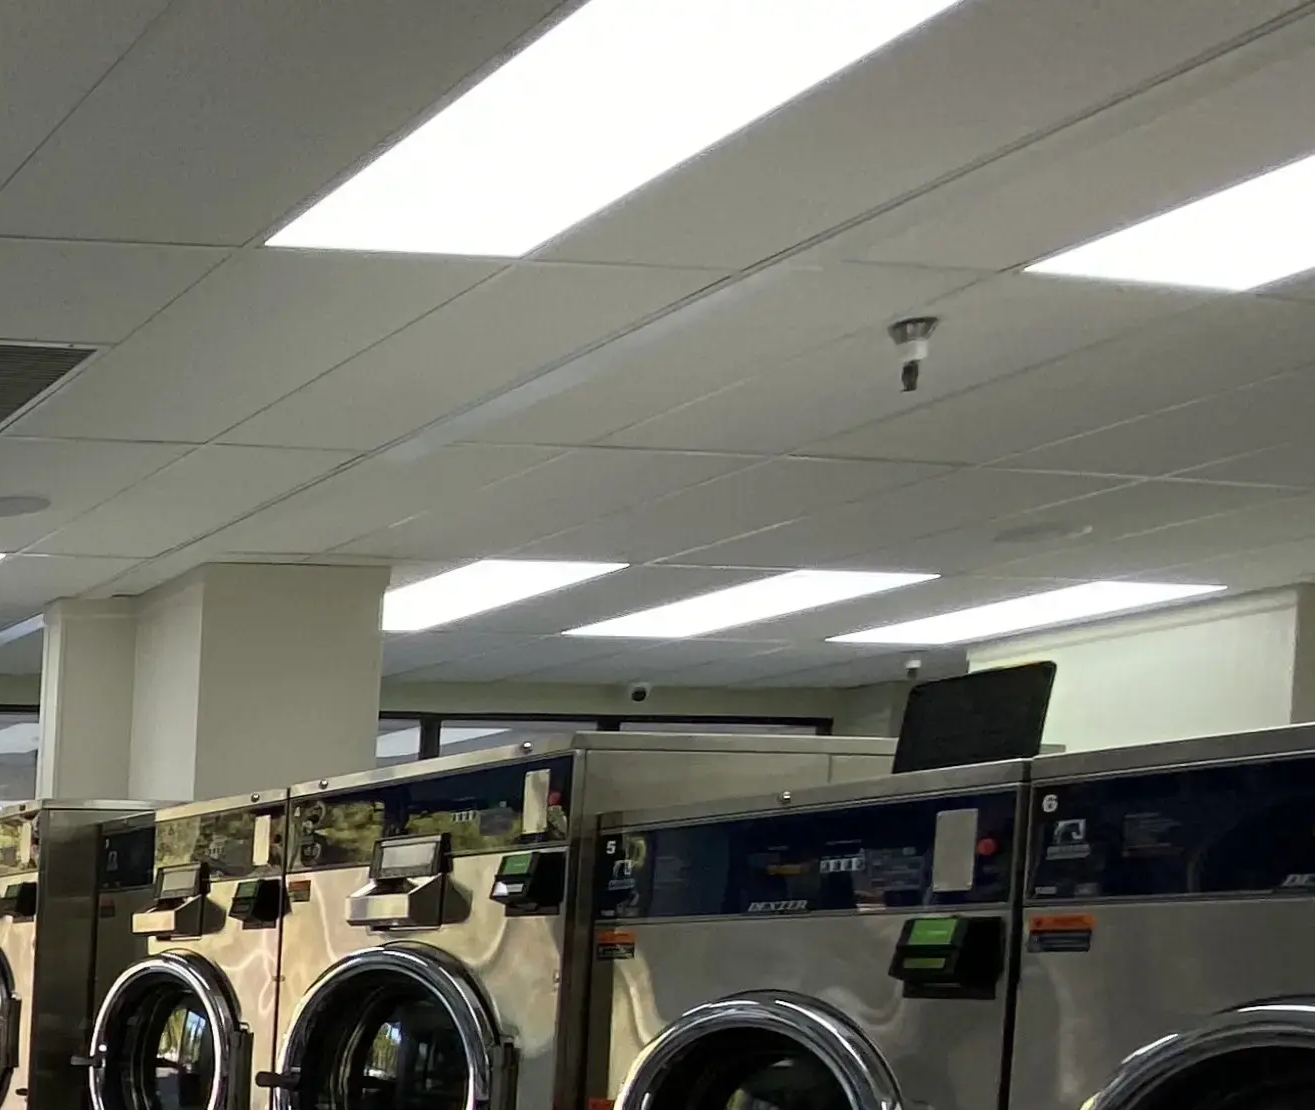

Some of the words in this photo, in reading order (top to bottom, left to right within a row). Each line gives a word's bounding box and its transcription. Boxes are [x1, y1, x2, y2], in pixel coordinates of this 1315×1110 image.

[1042, 794, 1058, 813] 6
[606, 840, 617, 855] 5
[748, 900, 808, 912] DEXTER
